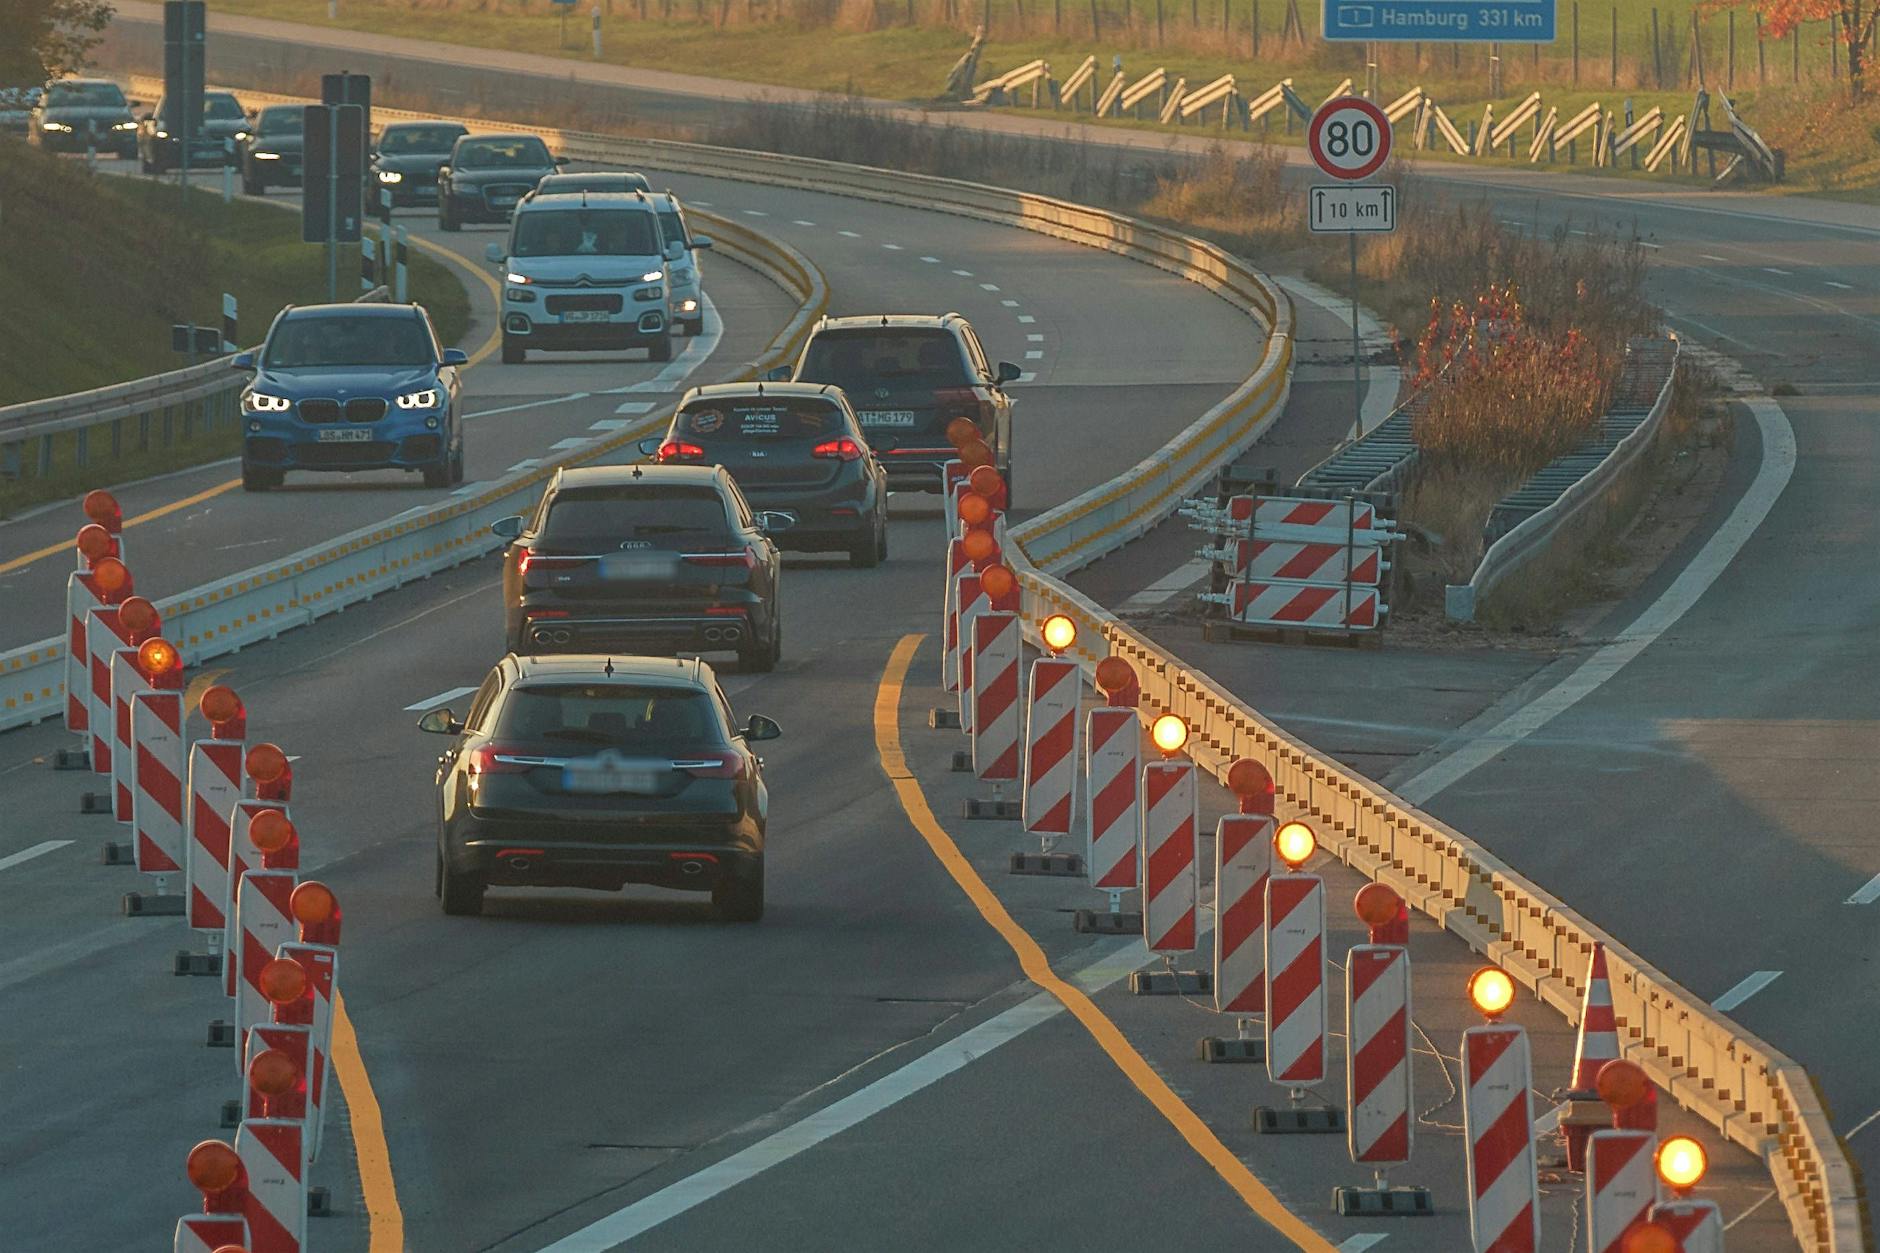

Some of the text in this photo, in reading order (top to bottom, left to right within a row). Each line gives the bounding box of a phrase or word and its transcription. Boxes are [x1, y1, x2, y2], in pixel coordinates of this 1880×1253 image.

[1382, 9, 1468, 30] Hamburg
[1479, 9, 1508, 27] 331
[1513, 9, 1543, 26] km
[1327, 120, 1373, 157] 80
[1330, 201, 1379, 218] 10 km
